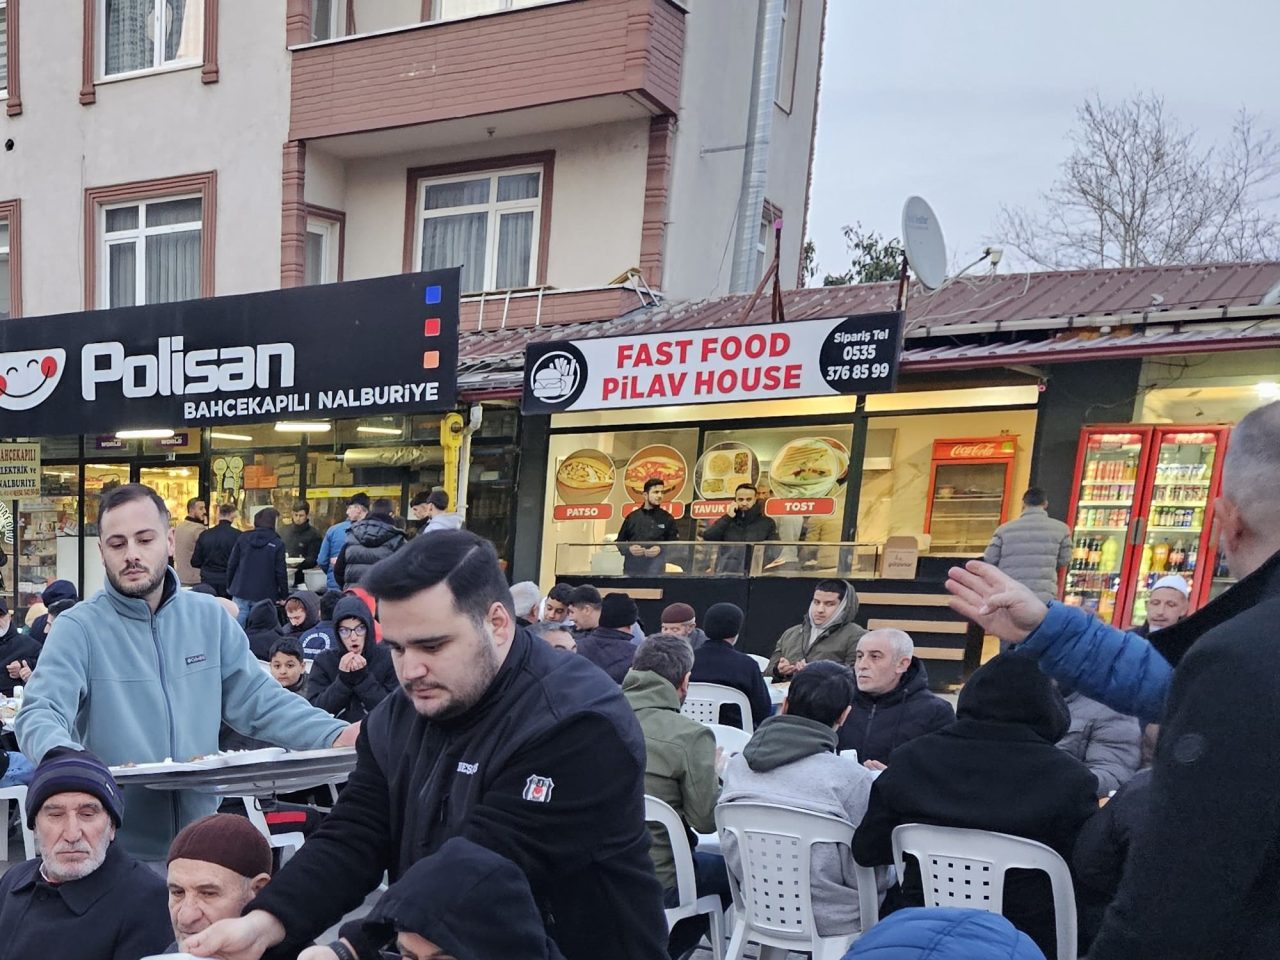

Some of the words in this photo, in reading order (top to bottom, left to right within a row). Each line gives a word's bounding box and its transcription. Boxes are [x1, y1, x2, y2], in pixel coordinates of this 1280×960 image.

[833, 330, 871, 345] Sipariş
[872, 328, 889, 342] Tel
[616, 339, 693, 369] FAST
[701, 331, 791, 363] FOOD
[842, 344, 877, 361] 0535
[81, 336, 295, 402] Polisan
[826, 365, 851, 381] 376
[852, 364, 870, 380] 85
[871, 362, 890, 378] 99
[693, 364, 803, 396] HOUSE
[183, 392, 311, 420] BAHÇEKAPILI
[566, 506, 599, 517] PATSO
[693, 503, 725, 514] TAVUK
[784, 501, 816, 512] TOST
